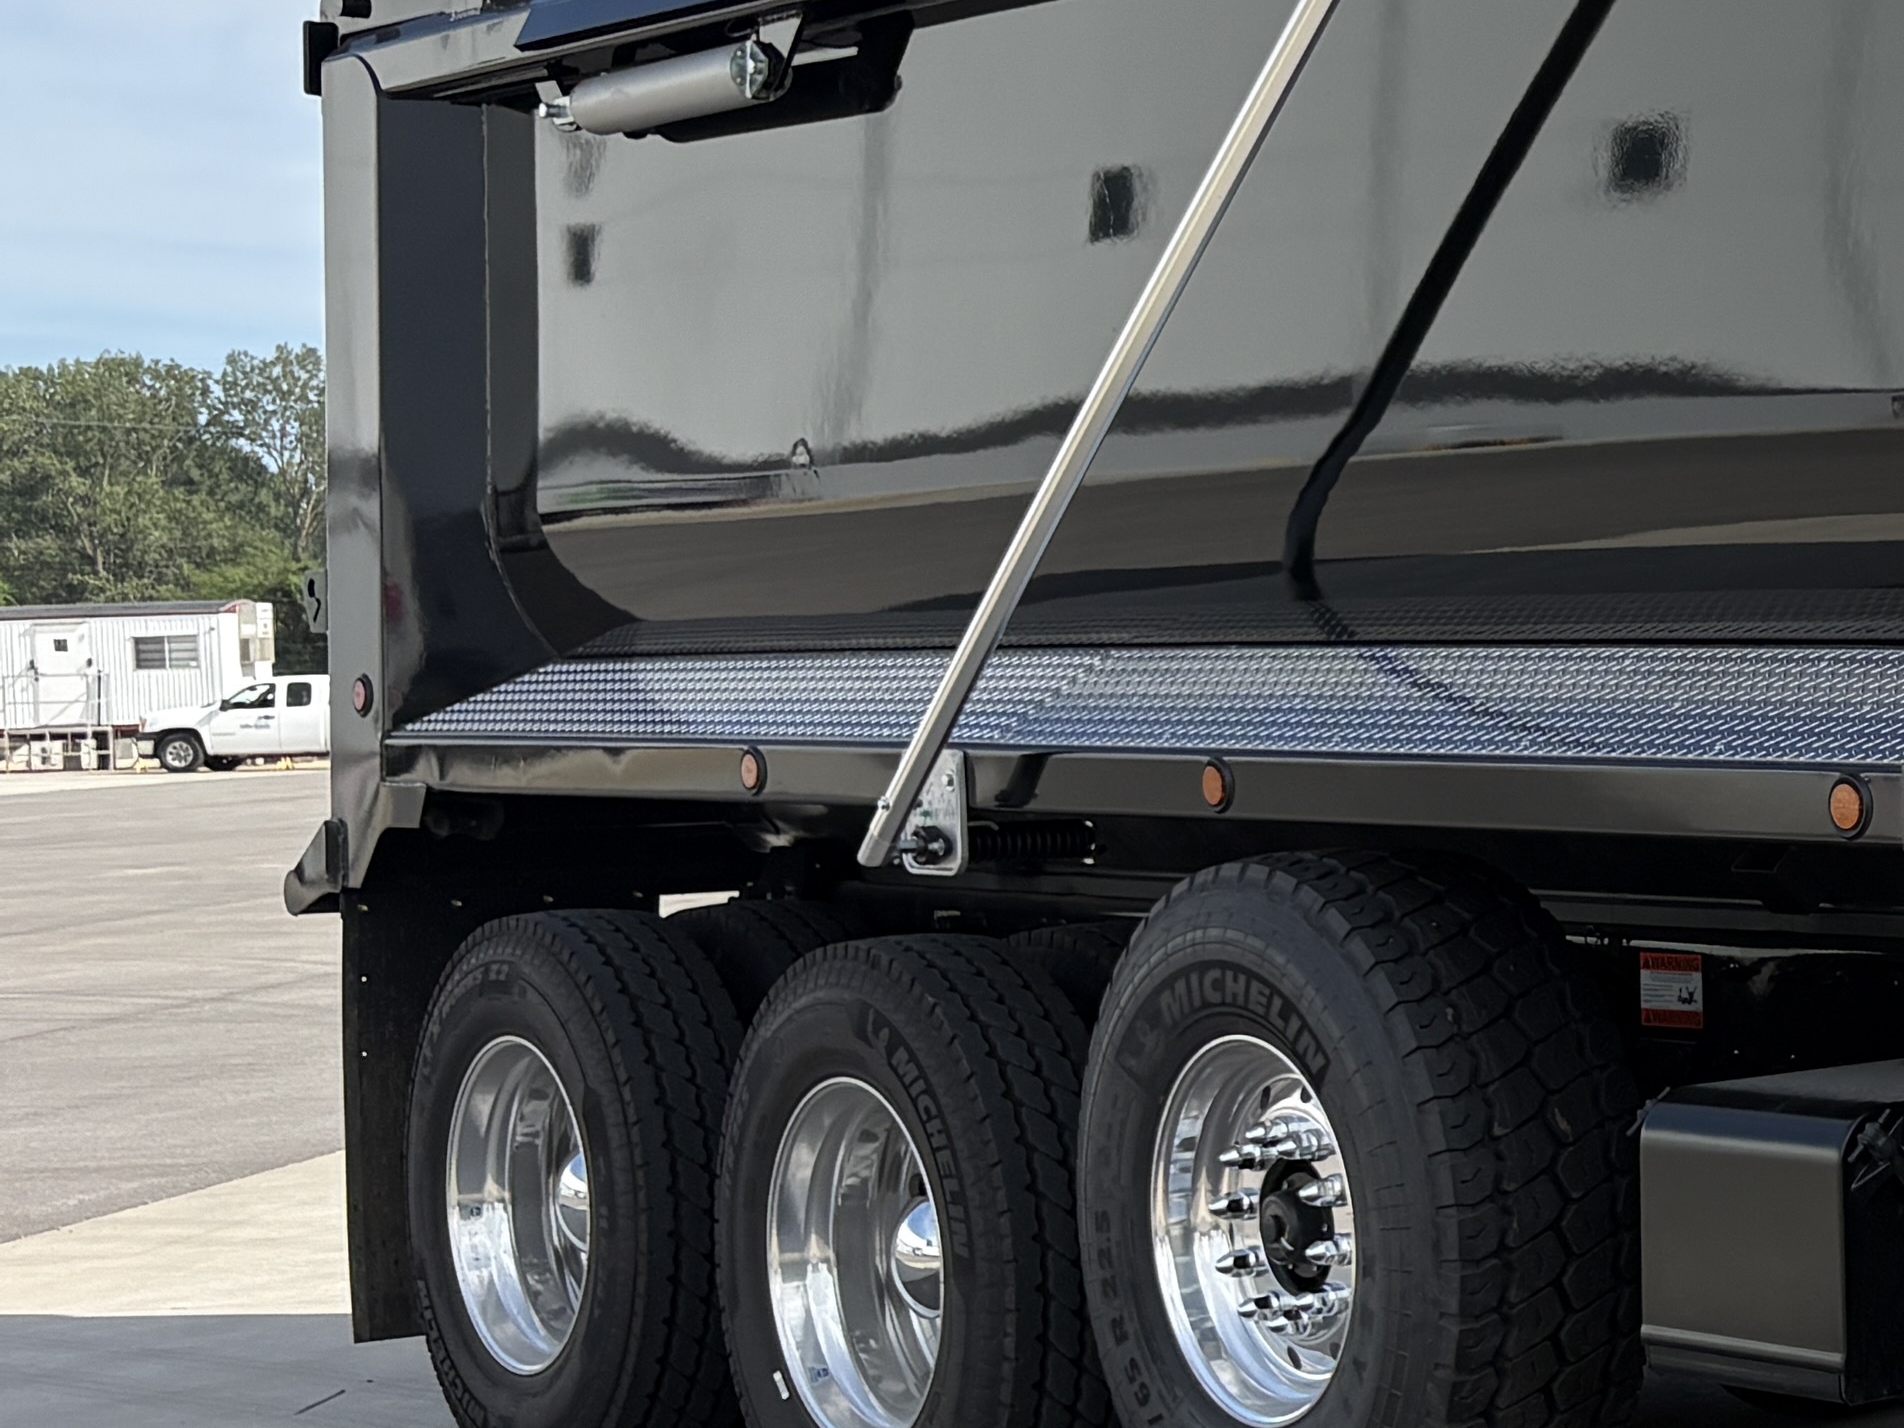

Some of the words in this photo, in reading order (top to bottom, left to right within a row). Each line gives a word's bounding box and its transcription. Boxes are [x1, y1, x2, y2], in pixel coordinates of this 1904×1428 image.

[1651, 955, 1700, 971] WARNING
[1159, 968, 1327, 1073] MICHELIN
[891, 1047, 971, 1259] MICHELIN
